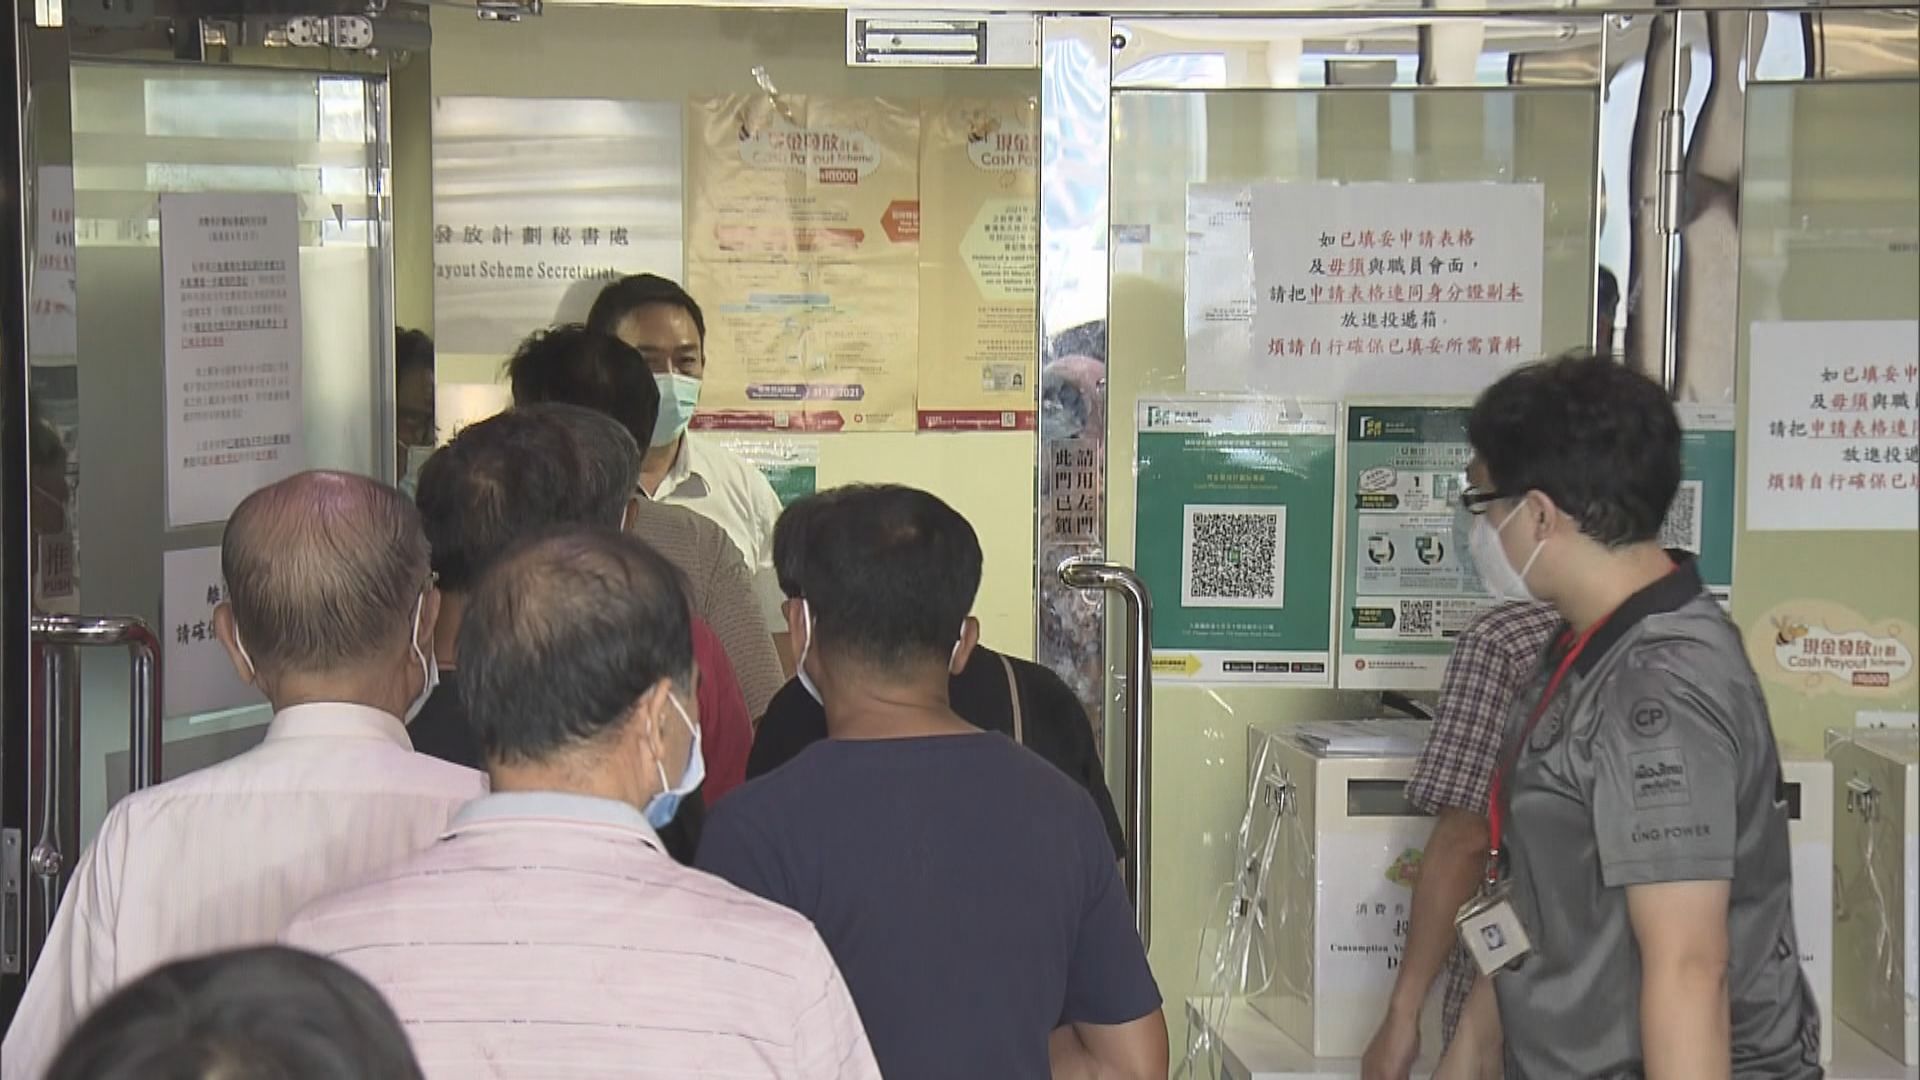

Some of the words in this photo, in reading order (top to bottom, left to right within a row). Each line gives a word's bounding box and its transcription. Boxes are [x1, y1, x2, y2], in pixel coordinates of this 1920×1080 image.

[981, 152, 1015, 166] Cash
[434, 224, 630, 246] 發放計劃秘書處
[1318, 228, 1475, 249] 如已填妥申請表格
[433, 262, 476, 279] ayout
[479, 260, 534, 279] Scheme
[537, 261, 615, 280] Secretariat
[1269, 283, 1524, 303] 請把申請表格連同身分證副本
[1267, 336, 1522, 357] 煩請自行確保已填妥所需資料
[1821, 363, 1918, 383] 如已填妥申
[1810, 391, 1918, 411] 及毋須與職
[1414, 476, 1420, 487] 1
[44, 577, 71, 591] PUSH
[1789, 656, 1821, 667] Cash
[1824, 657, 1867, 671] Payout
[1635, 708, 1663, 727] CP
[1663, 824, 1711, 839] POWER
[1330, 943, 1389, 955] Consumption
